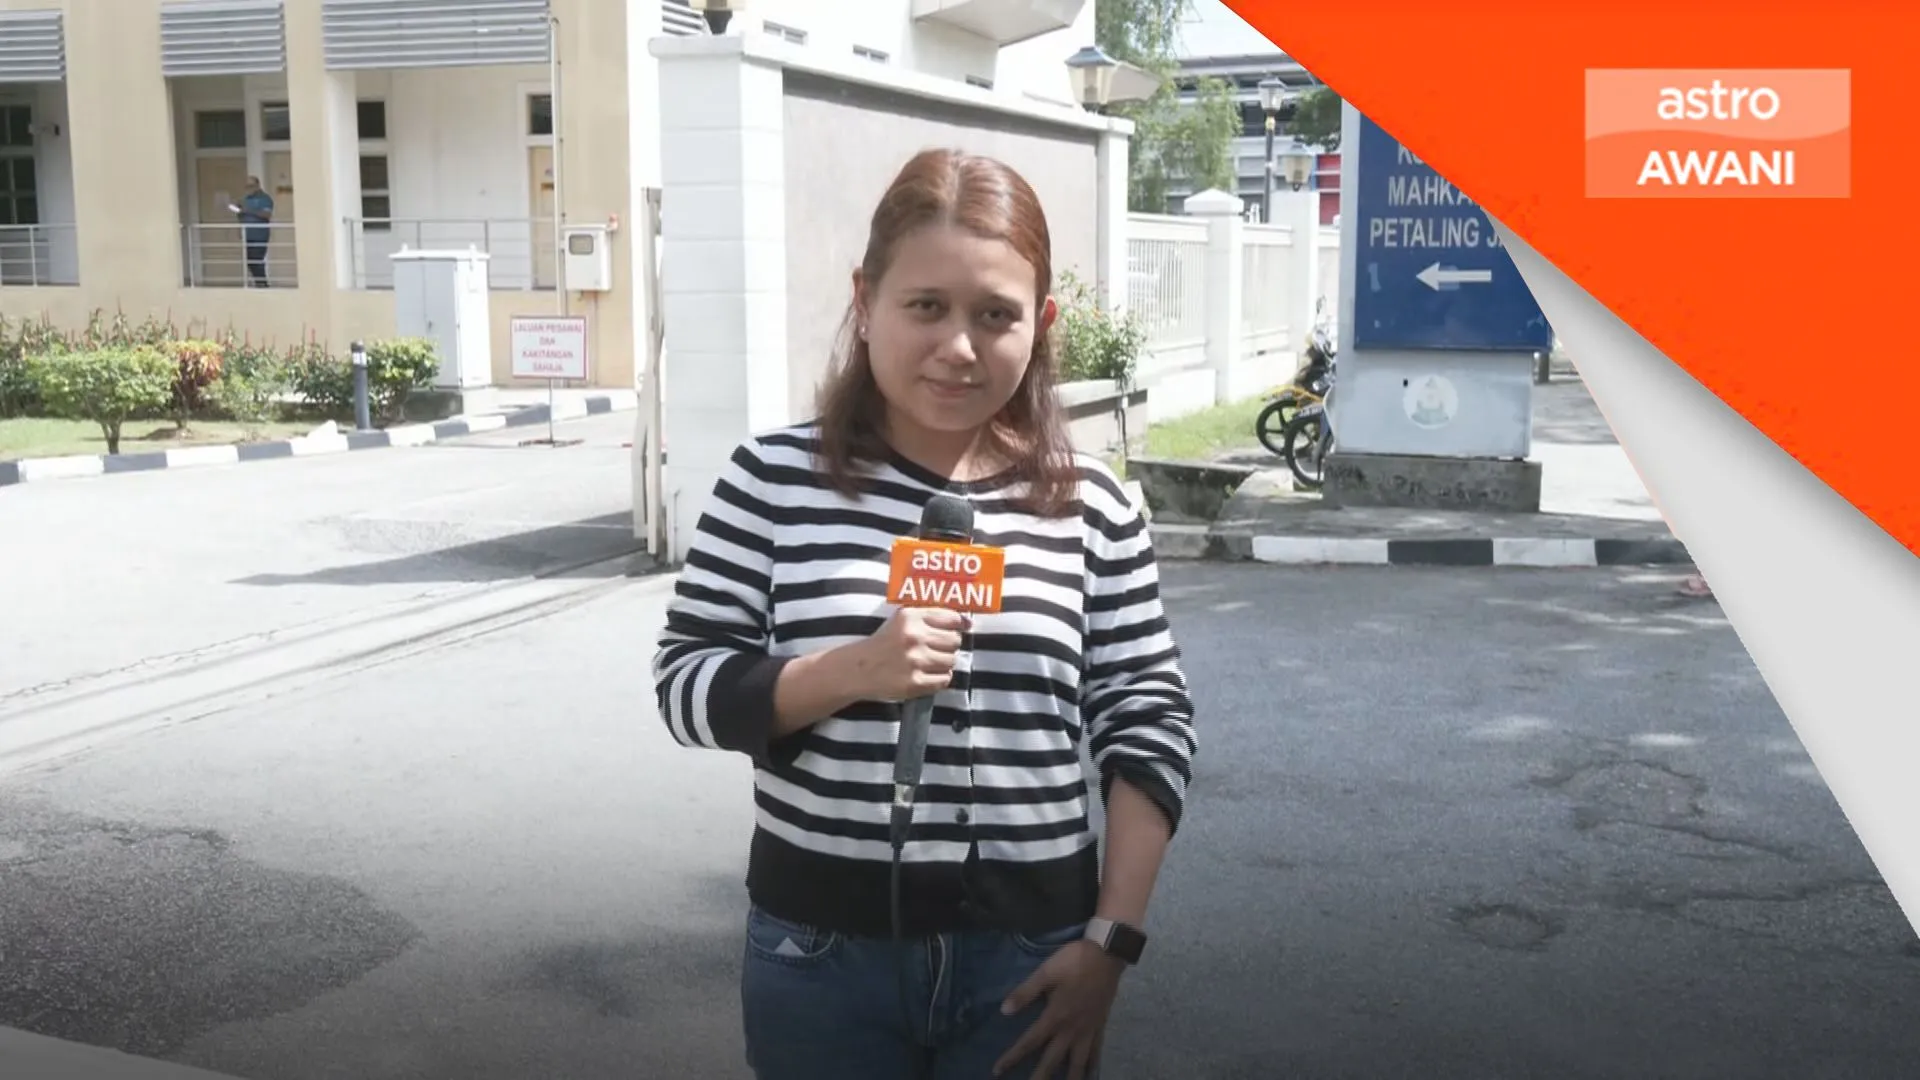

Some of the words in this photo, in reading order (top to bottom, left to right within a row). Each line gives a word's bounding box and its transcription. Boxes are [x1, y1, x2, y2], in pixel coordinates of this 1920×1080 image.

[1388, 175, 1480, 206] MAHKA
[1369, 217, 1479, 248] PETALING
[539, 336, 556, 346] DAN
[911, 547, 982, 575] astro
[898, 576, 993, 608] AWANI
